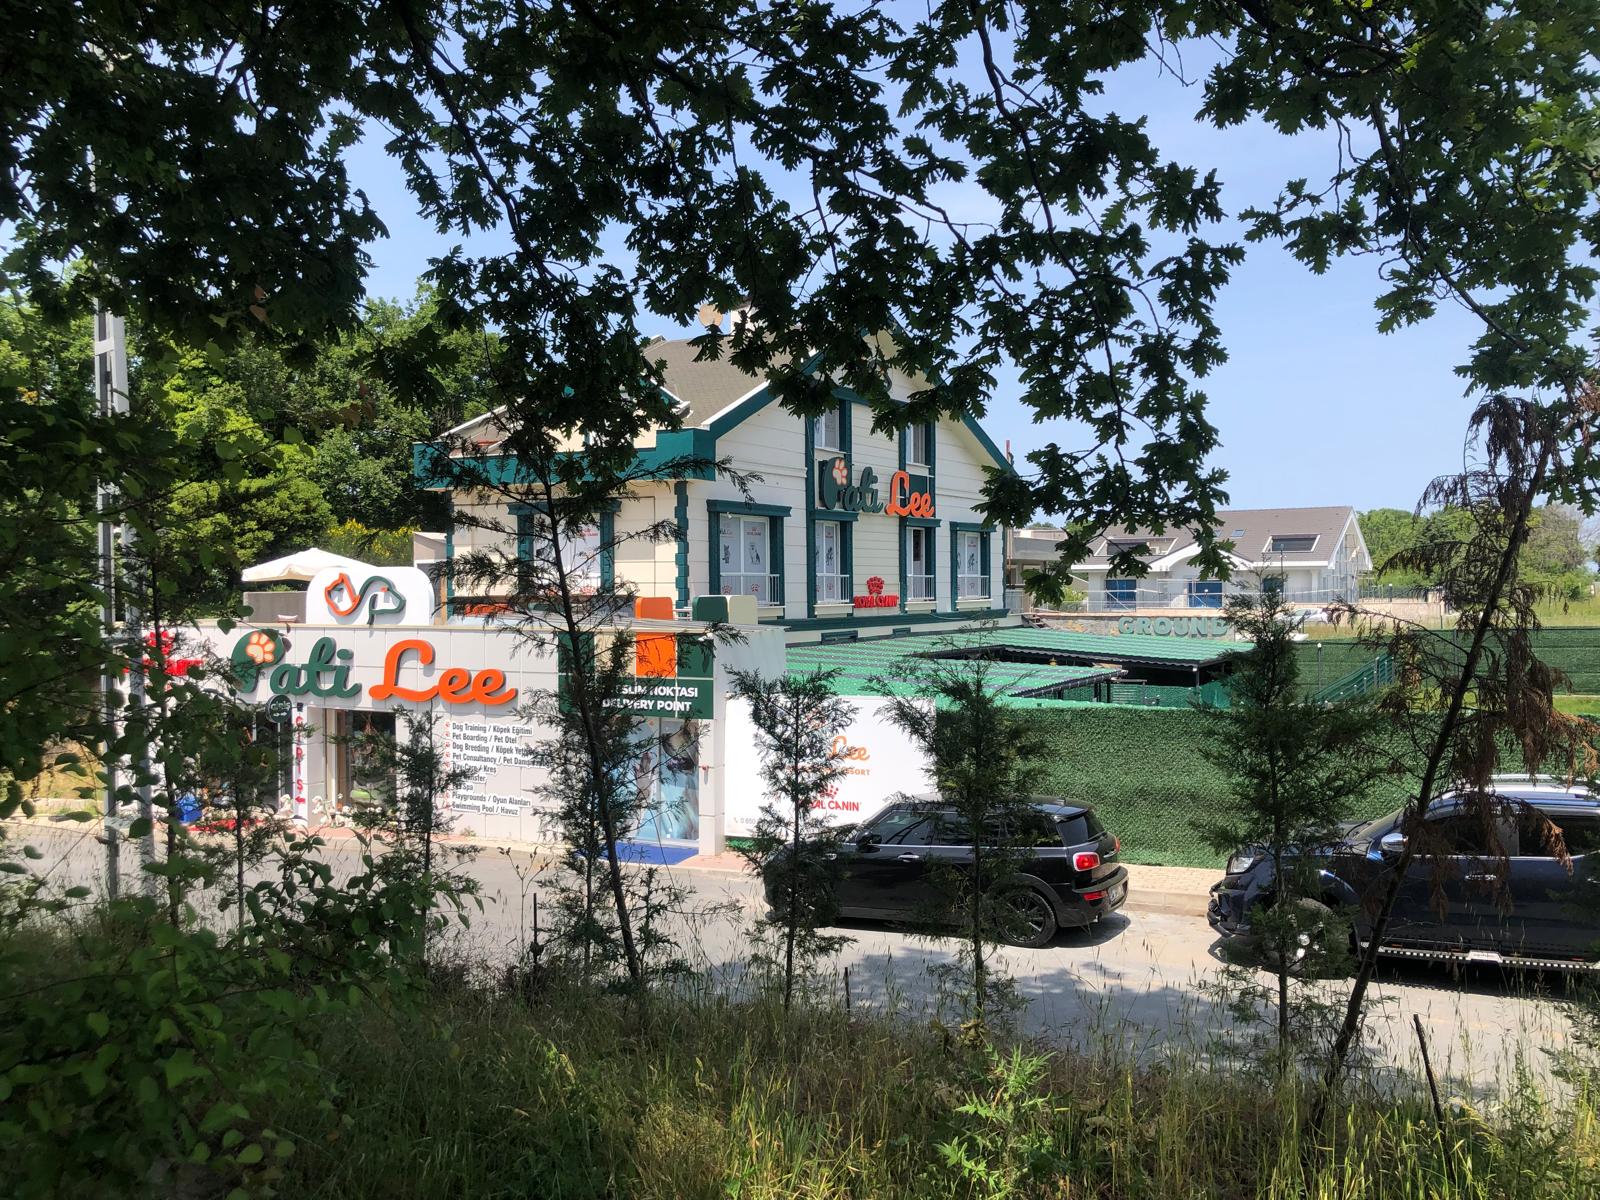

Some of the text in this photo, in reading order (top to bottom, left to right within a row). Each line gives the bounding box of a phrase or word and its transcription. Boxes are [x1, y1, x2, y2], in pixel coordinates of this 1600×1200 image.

[822, 457, 935, 517] Pati Lee
[1118, 617, 1228, 637] GROUND
[231, 629, 518, 705] Pati Lee
[657, 700, 692, 712] POINT
[452, 723, 463, 732] Dog
[465, 723, 486, 733] Training
[493, 725, 510, 734] Köpek
[452, 732, 461, 740] Pet
[463, 733, 488, 743] Boarding
[494, 735, 503, 743] Pet
[505, 736, 517, 744] Otel
[452, 742, 463, 751] Dog
[465, 743, 489, 754] Breeding
[452, 752, 461, 760] Pet
[463, 753, 497, 764] Consultancy
[503, 757, 512, 765] Pet
[452, 791, 486, 802] Playgrounds
[493, 795, 507, 804] Oyun
[452, 801, 480, 812] Swimming
[482, 804, 494, 813] Pool
[501, 807, 518, 815] Havuz
[828, 801, 859, 812] CANIN
